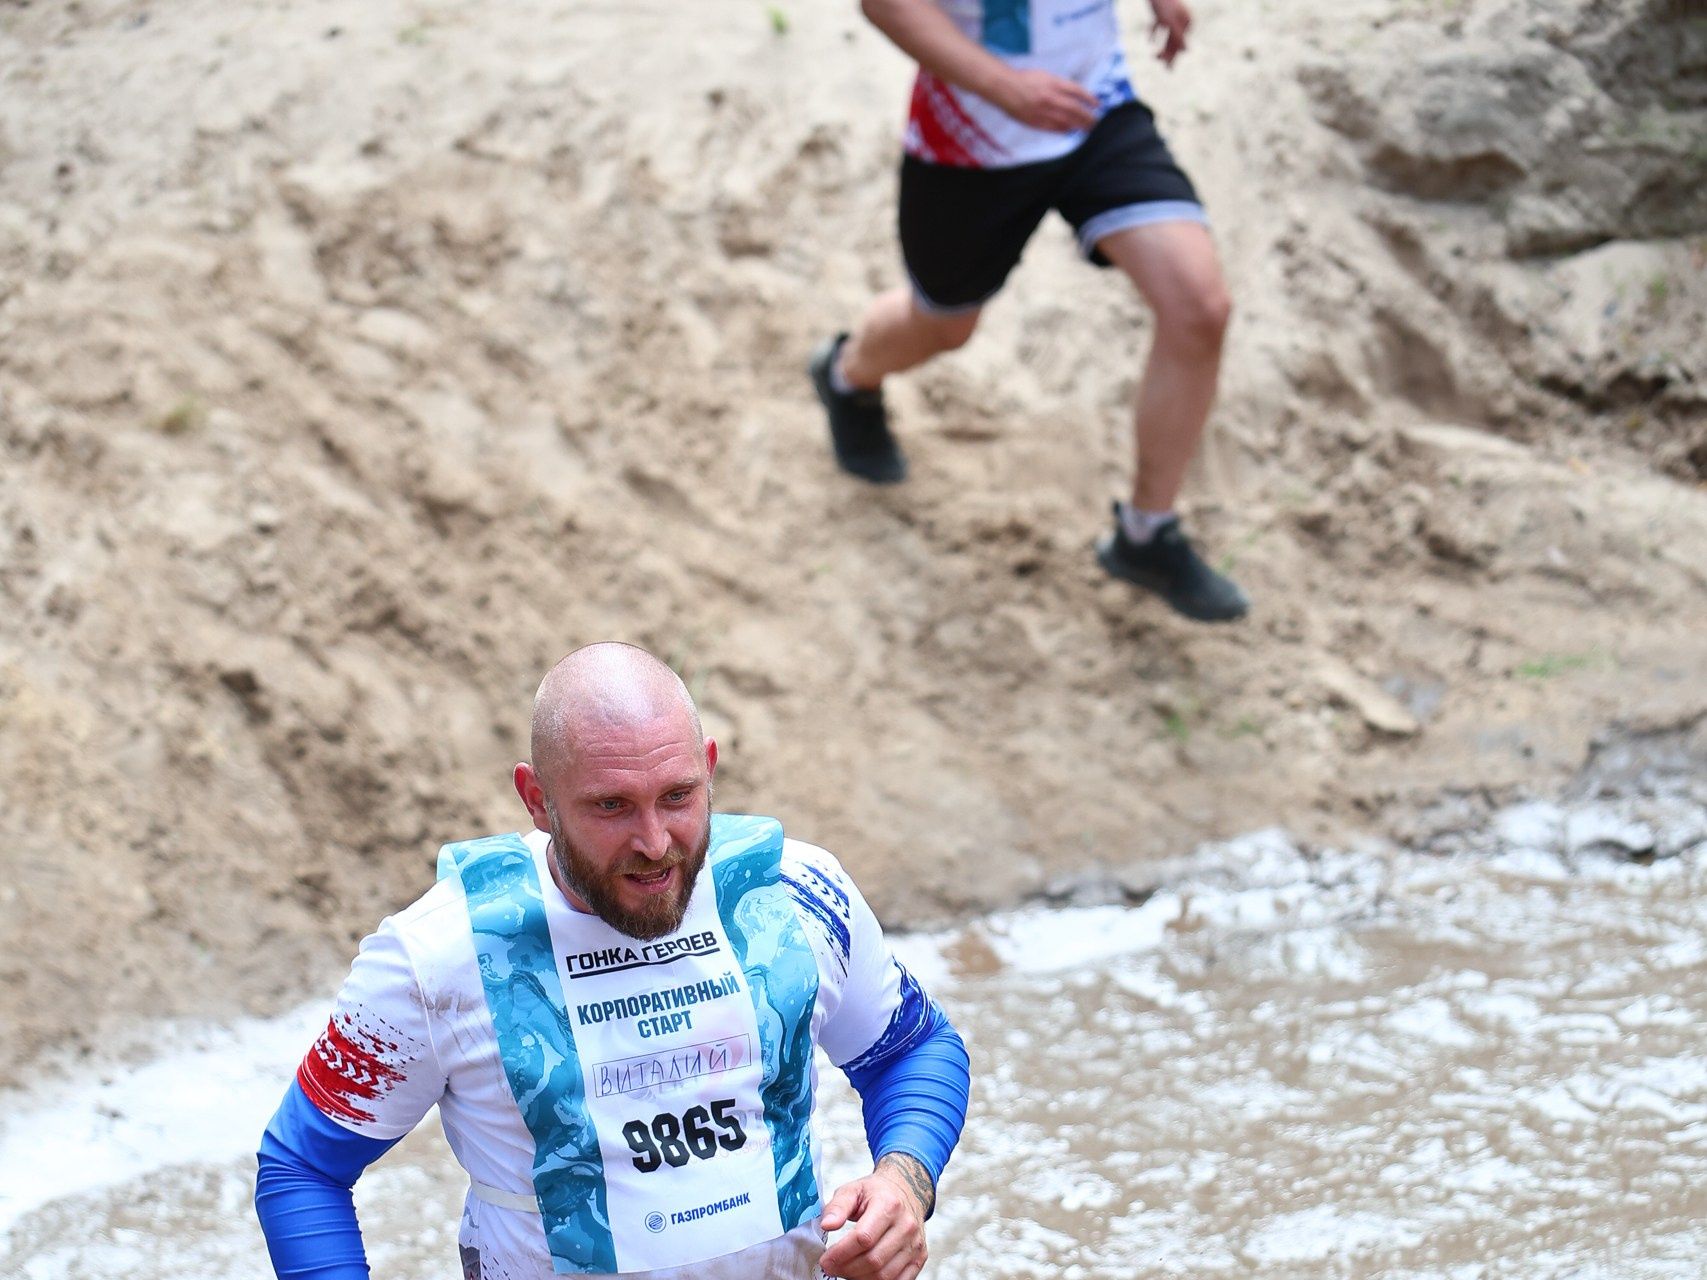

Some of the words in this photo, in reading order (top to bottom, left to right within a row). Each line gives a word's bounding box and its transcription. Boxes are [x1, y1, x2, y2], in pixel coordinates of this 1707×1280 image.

[566, 946, 636, 972] ГОНКА
[641, 930, 717, 961] ГЕРОЕВ
[577, 971, 741, 1026] КОРПОРАТИВНЫЙ
[637, 1010, 693, 1039] СТАРТ
[600, 1042, 727, 1096] ВИТАЛИЙ
[622, 1098, 747, 1173] 9865
[671, 1192, 751, 1225] ГАЗПРОМБАНК
